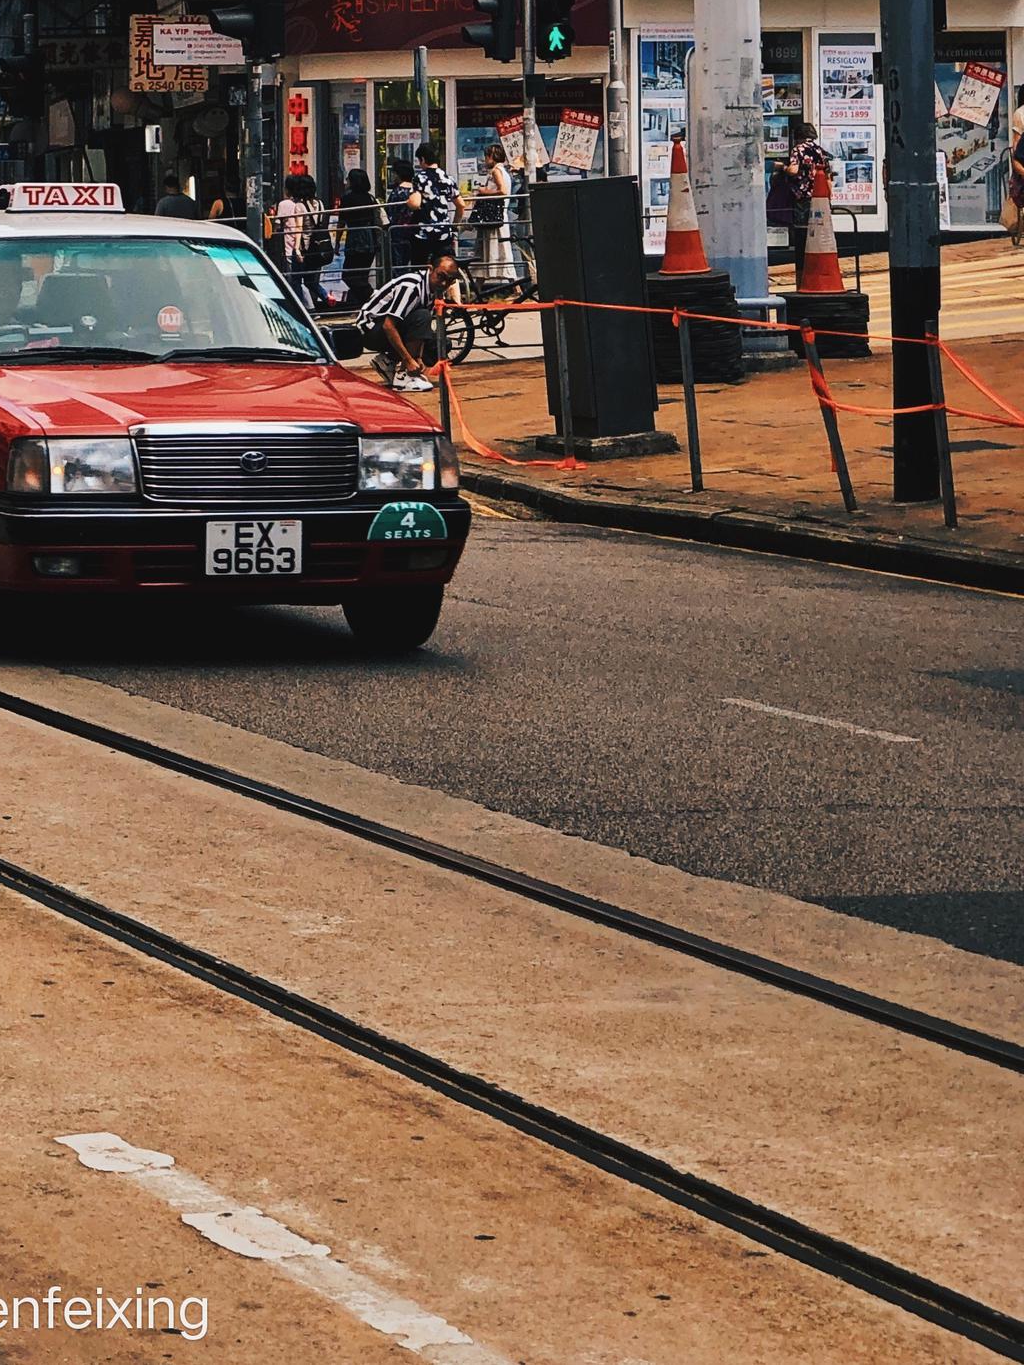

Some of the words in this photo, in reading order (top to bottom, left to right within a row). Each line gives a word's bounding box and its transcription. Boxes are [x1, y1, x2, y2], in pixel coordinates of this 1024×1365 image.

[149, 81, 174, 91] 2540
[178, 81, 205, 91] 1652
[22, 186, 115, 206] TAXI
[400, 511, 417, 528] 4
[235, 522, 274, 548] EX
[384, 529, 431, 539] SEATS
[213, 547, 295, 573] 9663
